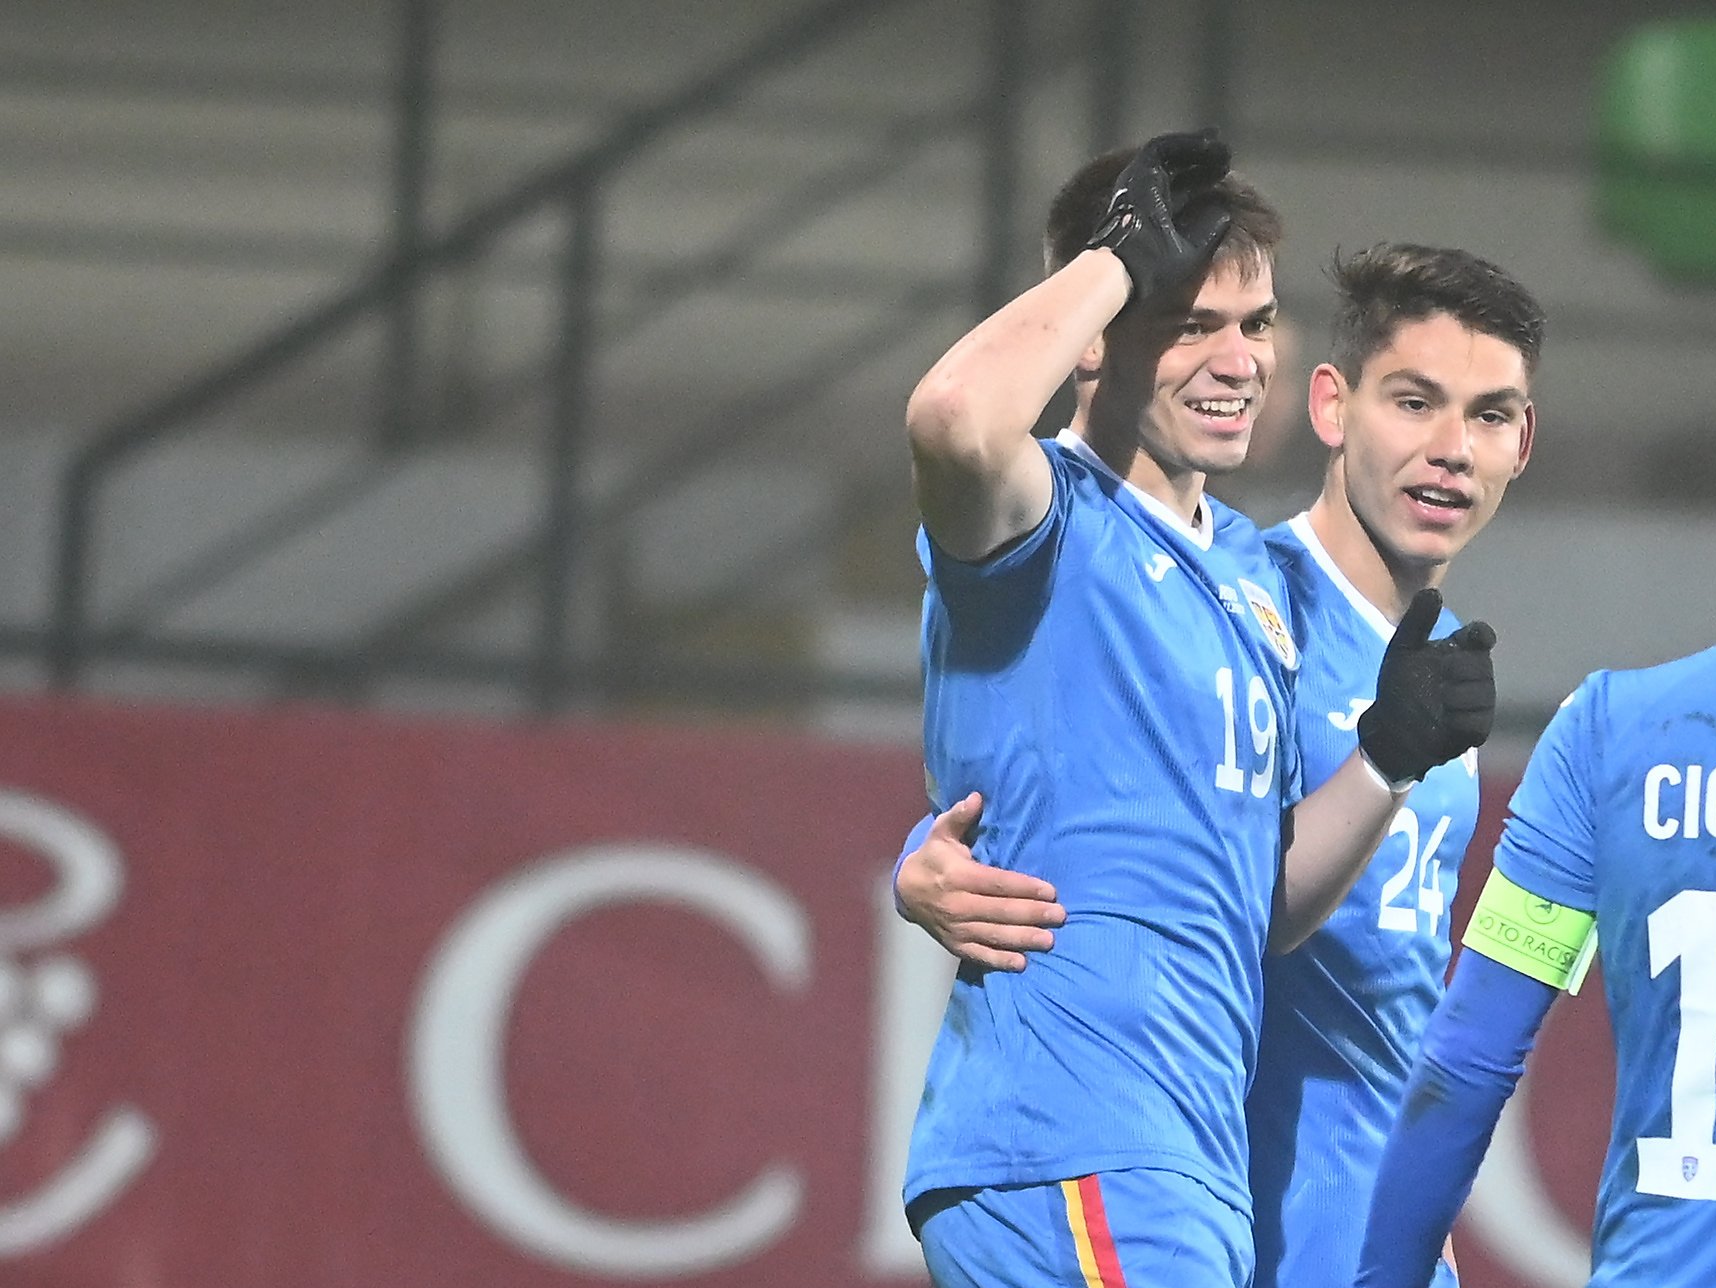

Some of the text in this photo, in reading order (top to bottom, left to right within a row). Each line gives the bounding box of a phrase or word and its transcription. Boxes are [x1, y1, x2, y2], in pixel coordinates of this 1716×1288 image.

[1215, 667, 1277, 798] 19
[1377, 807, 1452, 937] 24
[1498, 922, 1519, 942] TO
